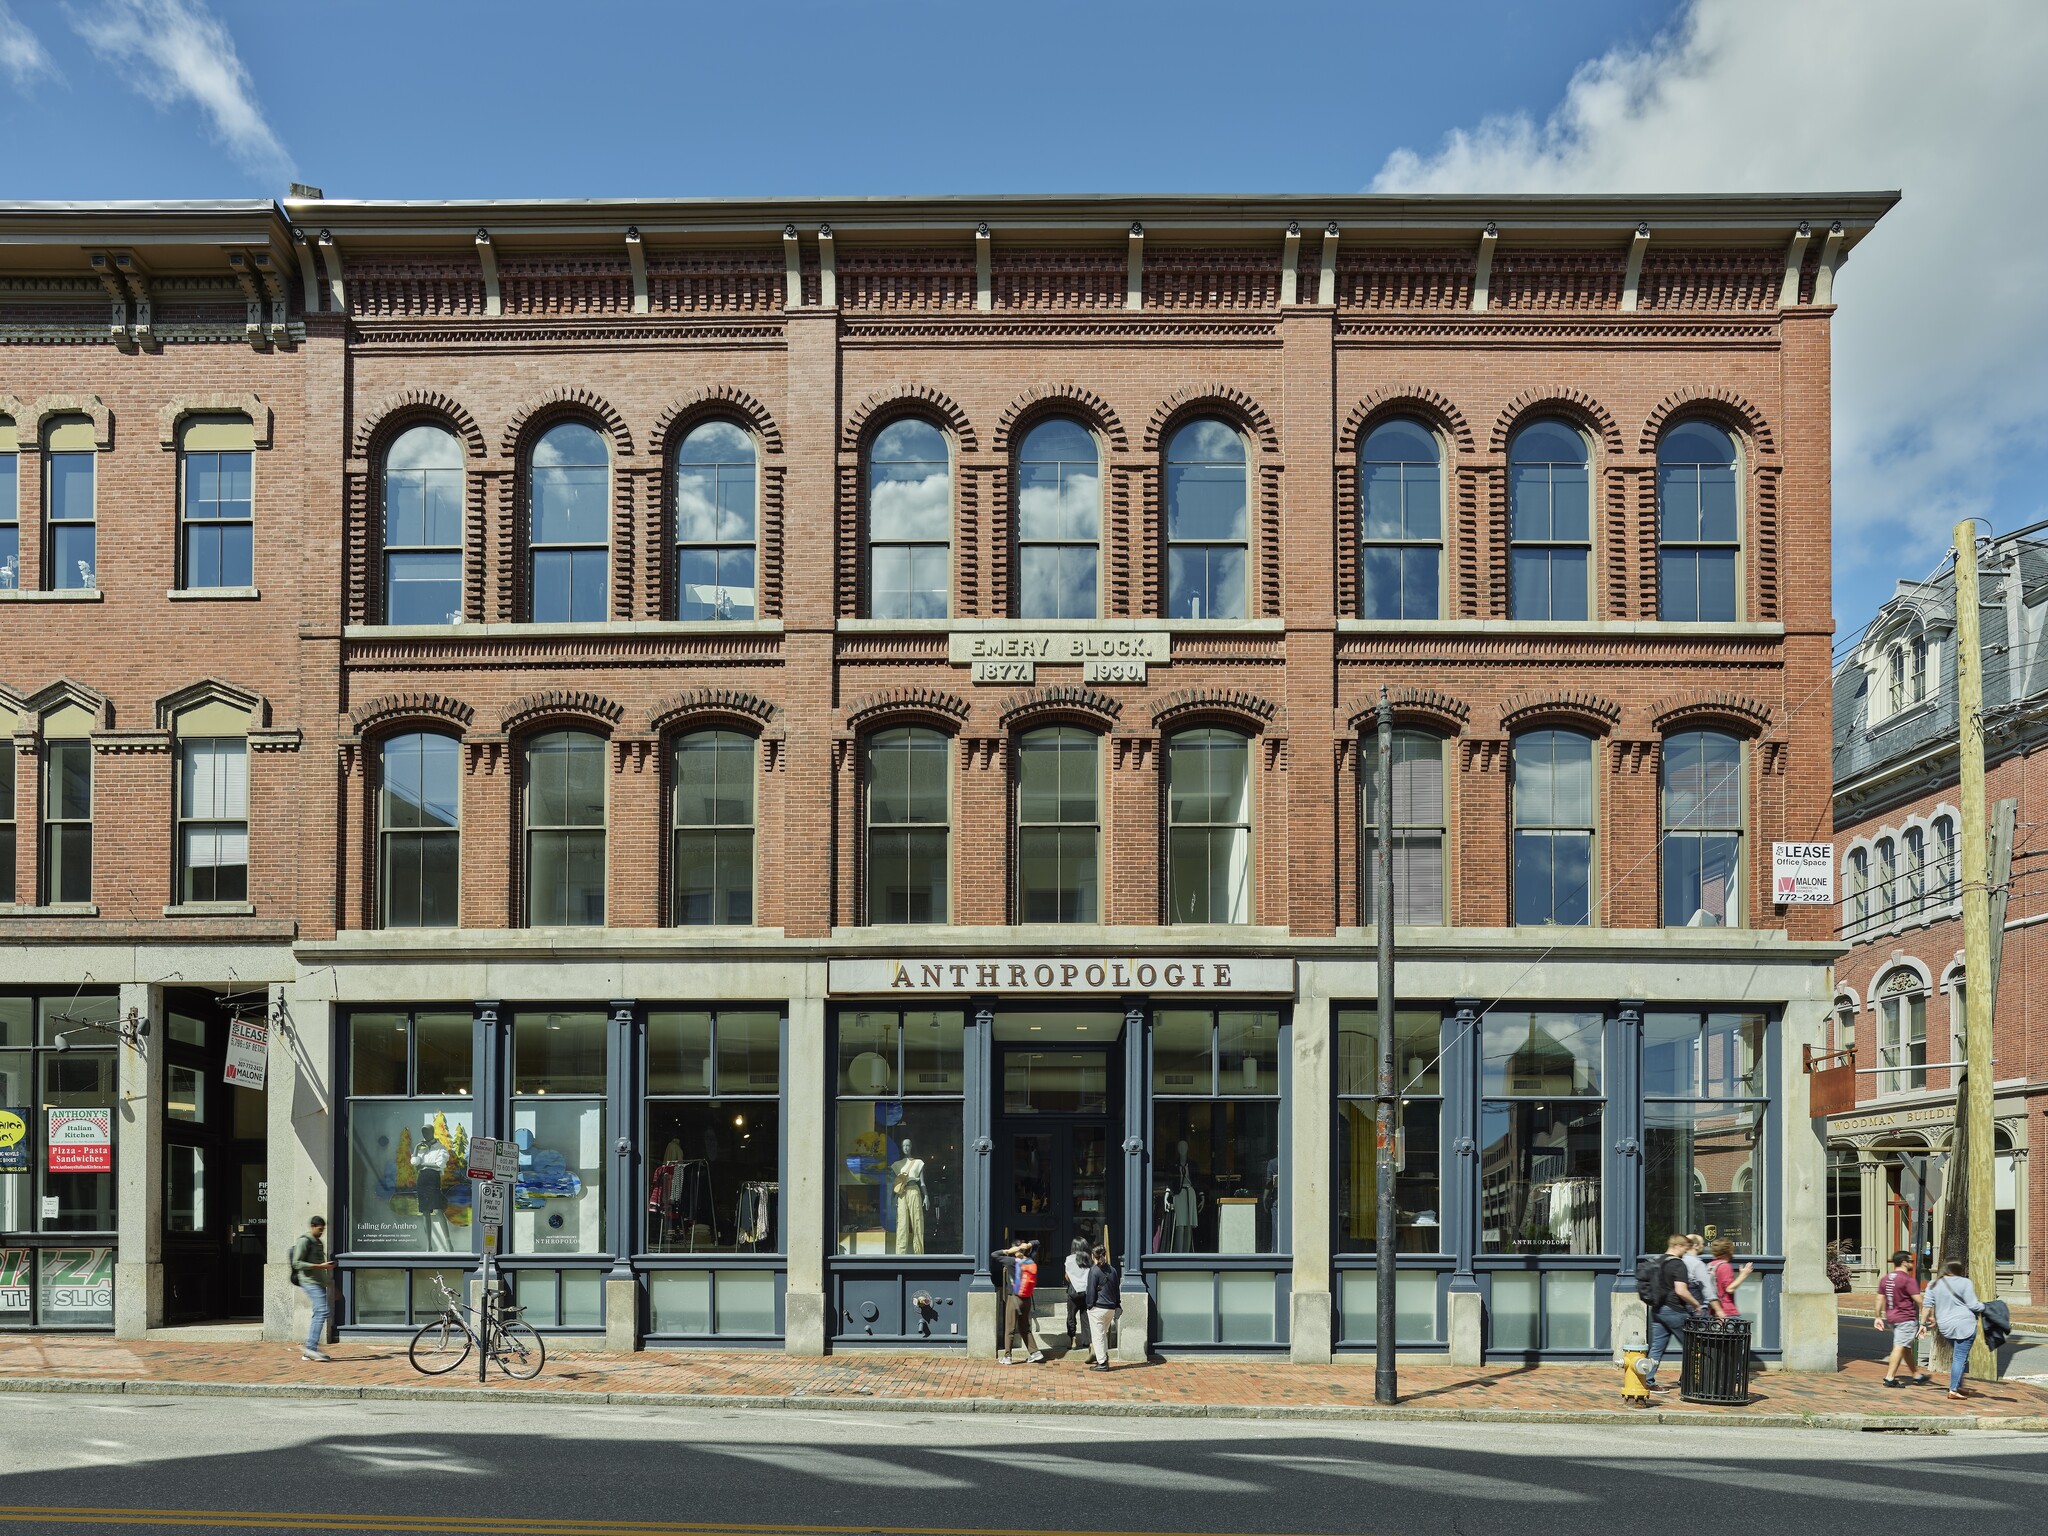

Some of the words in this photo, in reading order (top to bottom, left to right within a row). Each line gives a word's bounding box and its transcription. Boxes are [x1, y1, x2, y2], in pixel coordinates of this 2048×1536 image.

[971, 638, 1049, 657] EMERY
[1776, 845, 1784, 856] FOR
[1785, 846, 1831, 858] LEASE
[1776, 858, 1800, 866] Office
[1803, 859, 1827, 867] Space
[1796, 877, 1828, 886] MALONE
[1778, 894, 1830, 902] 772-2422
[890, 963, 1233, 989] ANTHROPOLOGIE
[232, 1023, 240, 1034] FOR
[240, 1026, 268, 1042] LEASE
[236, 1069, 263, 1082] MALONE
[51, 1110, 109, 1118] ANTHONY'S
[1834, 1114, 1896, 1131] WOODMAN
[52, 1146, 76, 1154] Pizza
[83, 1146, 108, 1154] Pasta
[56, 1154, 104, 1163] Sandwiches
[357, 1222, 380, 1231] Falling
[380, 1222, 391, 1230] for
[392, 1222, 418, 1230] Anthro
[0, 1248, 112, 1288] IZZA
[54, 1289, 112, 1307] SLIC
